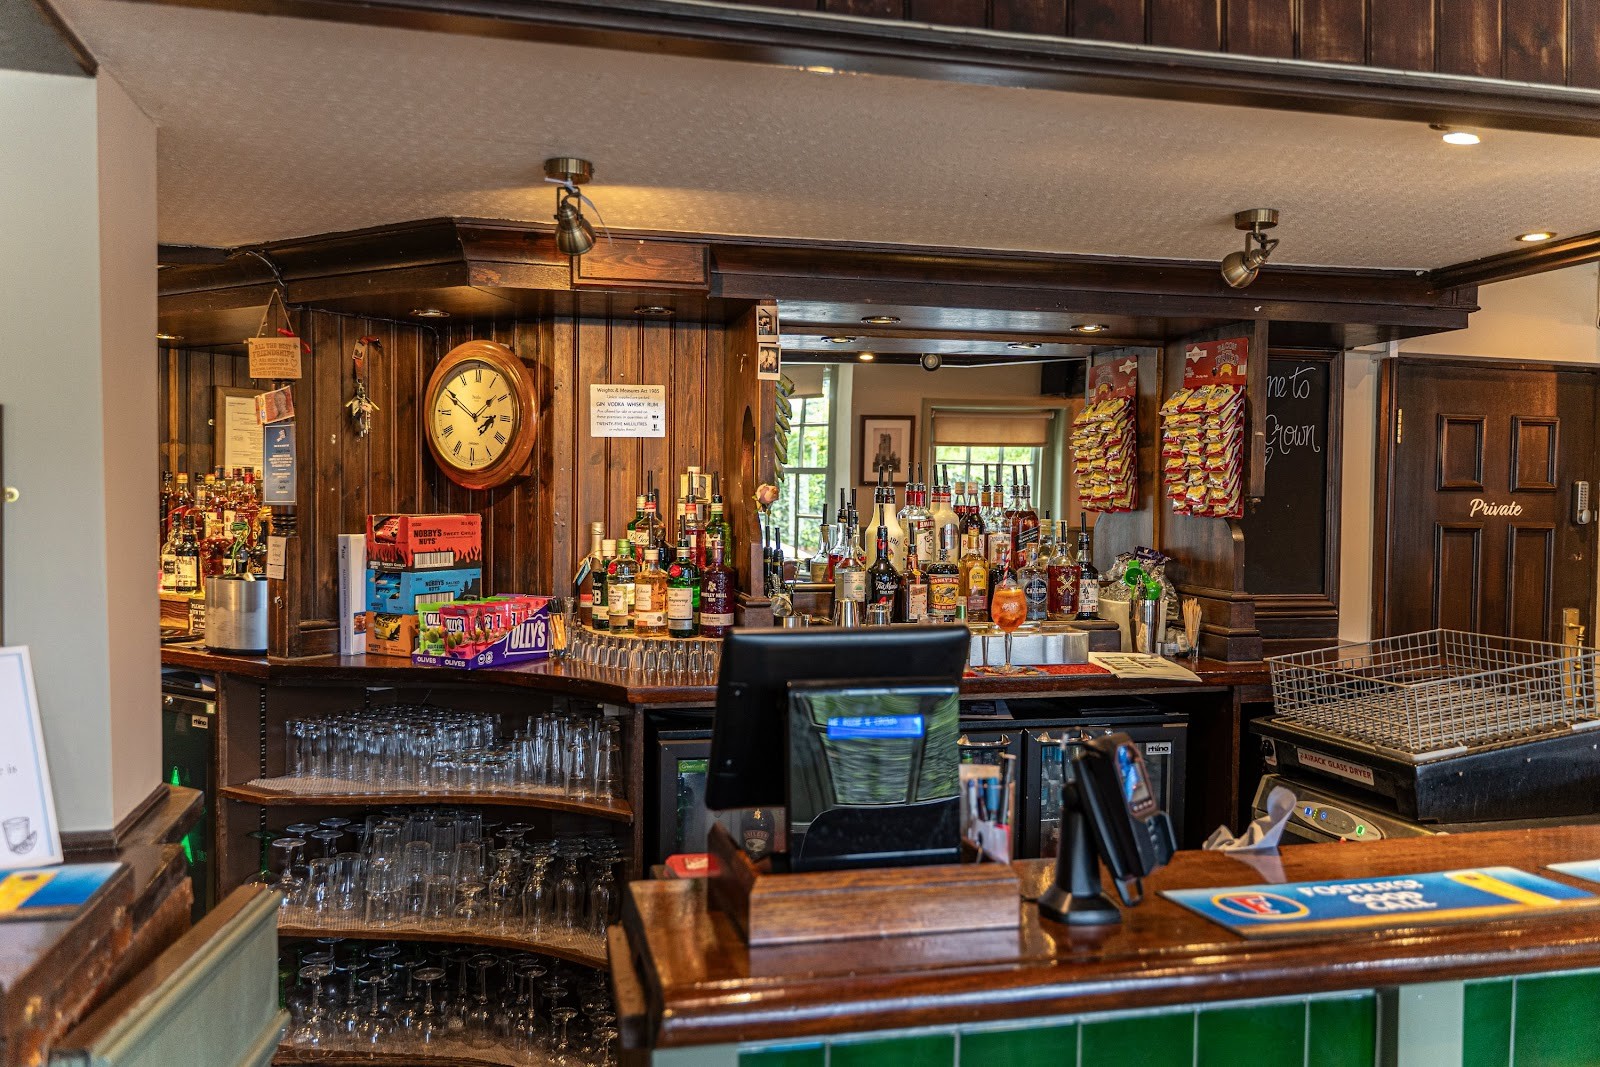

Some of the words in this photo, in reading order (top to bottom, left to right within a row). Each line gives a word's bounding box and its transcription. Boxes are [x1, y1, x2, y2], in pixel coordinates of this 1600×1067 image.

[252, 350, 294, 358] FRIENDSHIPS
[1289, 367, 1316, 398] to
[1265, 414, 1321, 455] Crown
[1470, 498, 1523, 518] Private
[414, 529, 442, 538] NOBBY'S
[427, 613, 440, 625] OLL
[446, 617, 465, 633] OLLY'S
[510, 620, 546, 650] OLLY'S
[445, 659, 466, 667] OLIVES
[193, 718, 207, 726] rhino
[1328, 760, 1348, 772] GLASS
[1349, 766, 1372, 779] DRYER
[1348, 890, 1424, 903] GOOD
